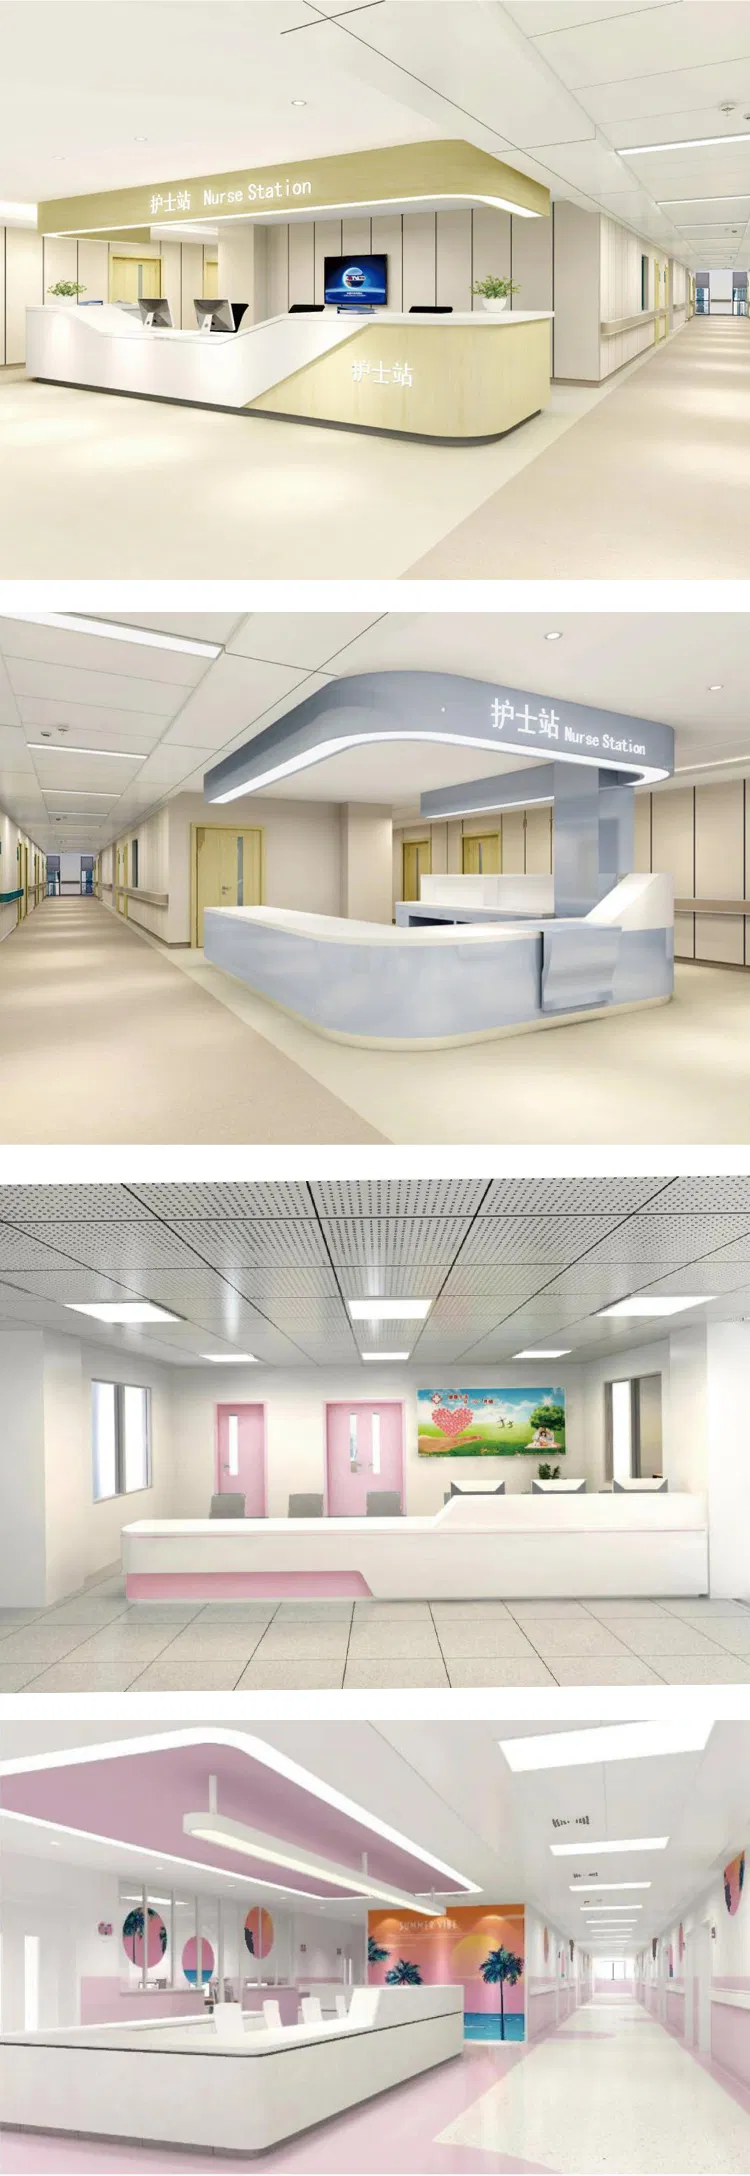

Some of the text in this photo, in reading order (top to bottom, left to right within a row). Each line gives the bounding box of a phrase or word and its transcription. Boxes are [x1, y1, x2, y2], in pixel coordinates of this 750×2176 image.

[150, 179, 312, 214] 护士站 Nurse Station
[352, 359, 414, 387] 护士站
[490, 697, 646, 755] 护士站 Nurse Station
